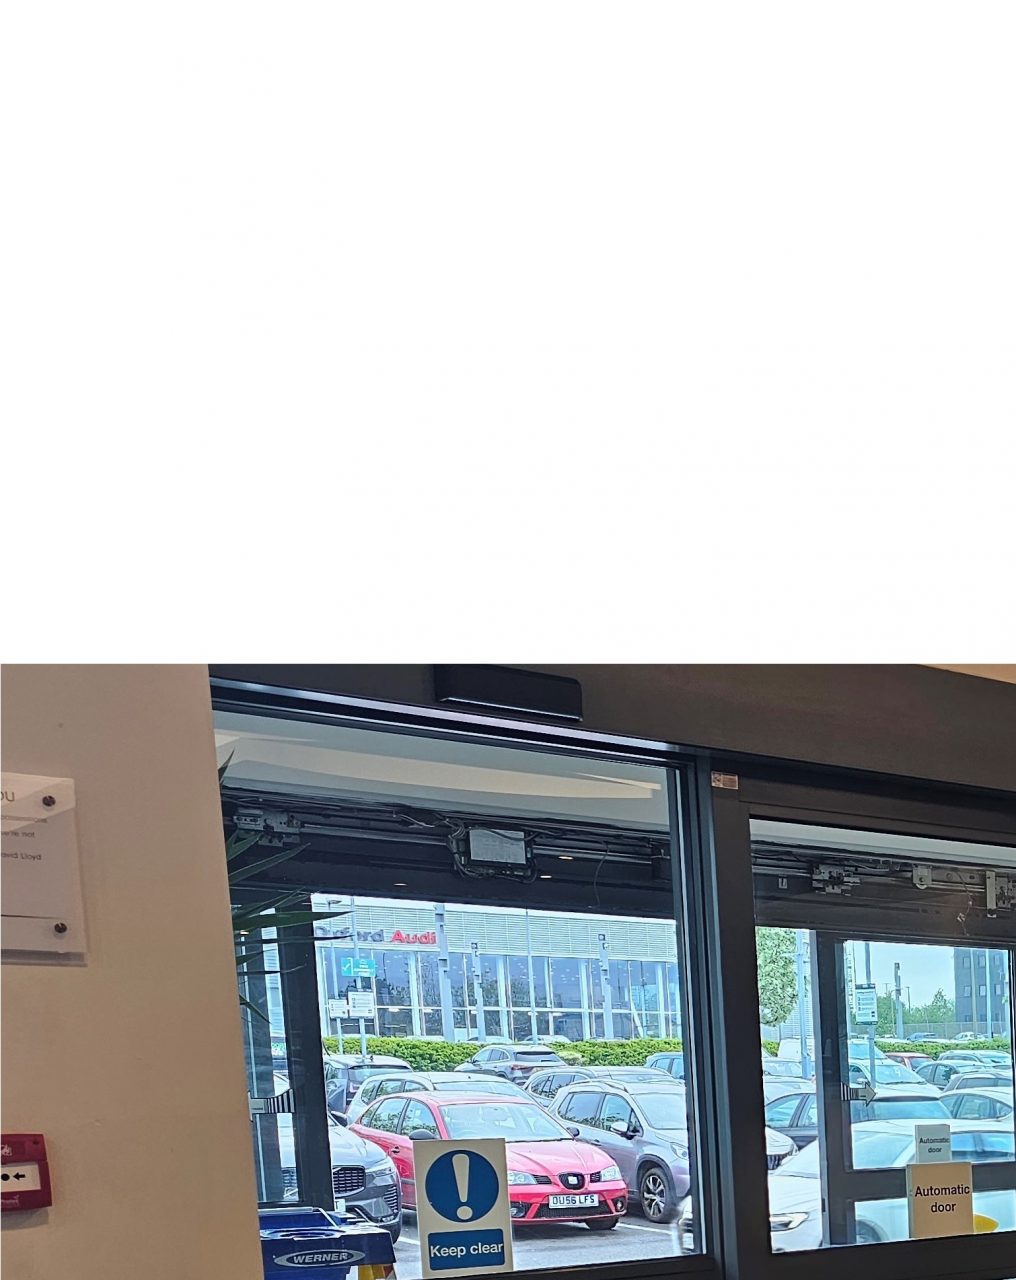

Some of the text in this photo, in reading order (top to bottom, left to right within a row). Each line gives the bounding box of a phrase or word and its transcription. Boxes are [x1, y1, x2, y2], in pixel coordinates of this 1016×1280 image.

[391, 929, 437, 944] Audi
[914, 1183, 971, 1198] Automatic
[930, 1201, 957, 1213] door
[430, 1241, 504, 1258] Keep clear
[293, 1252, 349, 1264] WERNER
